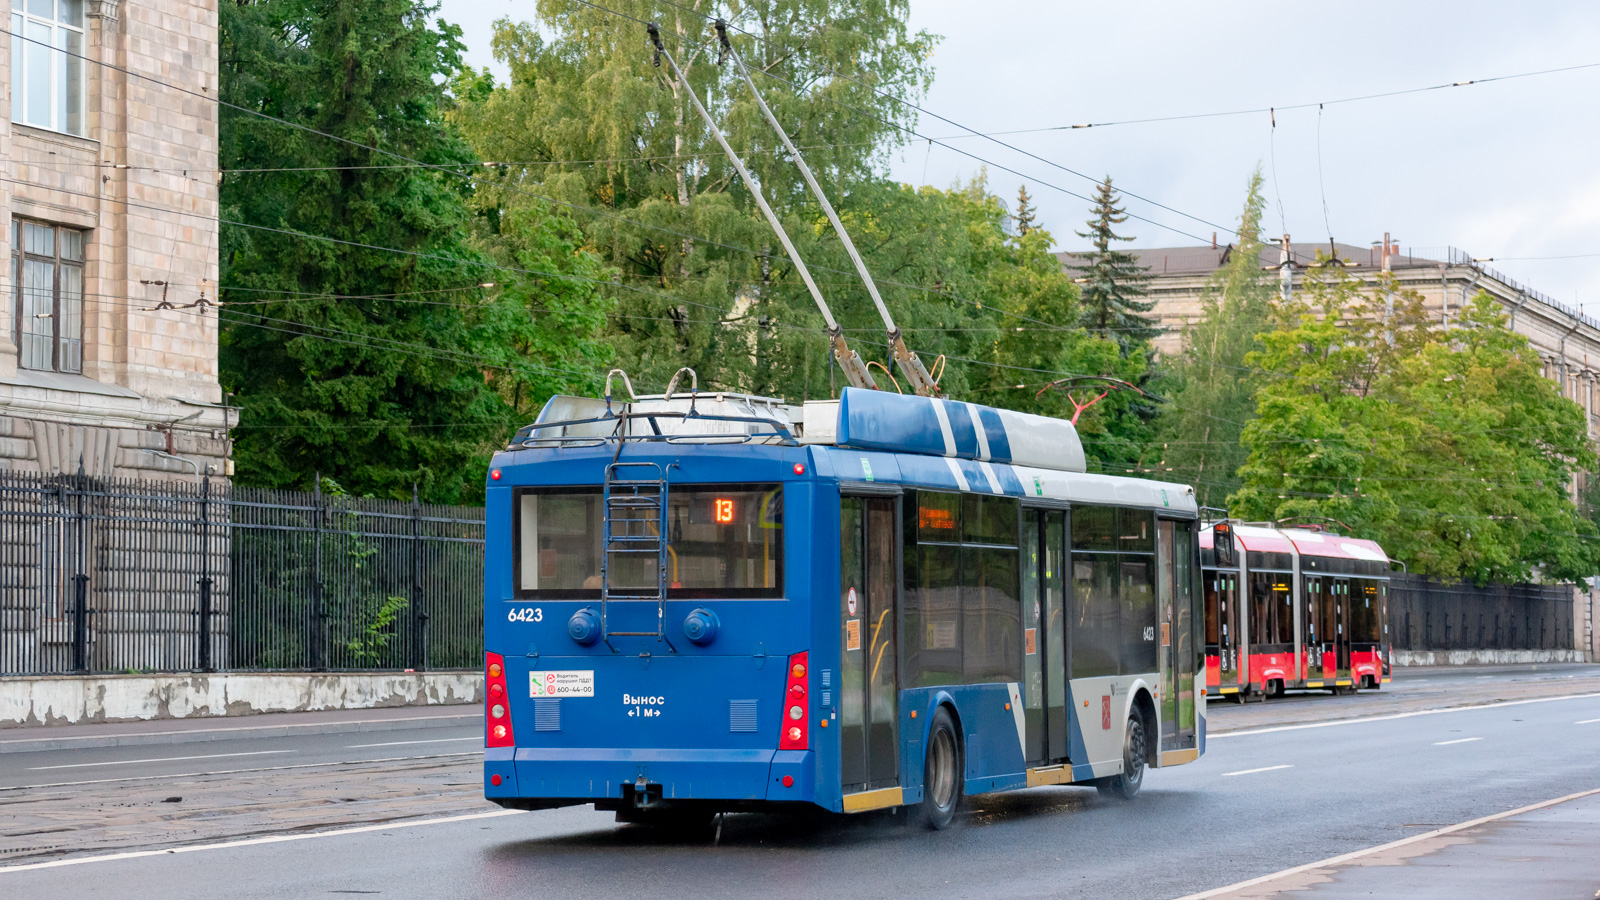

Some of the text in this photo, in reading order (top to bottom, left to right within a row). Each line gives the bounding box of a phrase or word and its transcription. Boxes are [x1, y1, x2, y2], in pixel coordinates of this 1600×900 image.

[715, 499, 733, 522] 13
[508, 608, 543, 622] 6423
[1143, 626, 1155, 641] 6423
[623, 694, 665, 705] Вынос
[635, 706, 640, 717] 1
